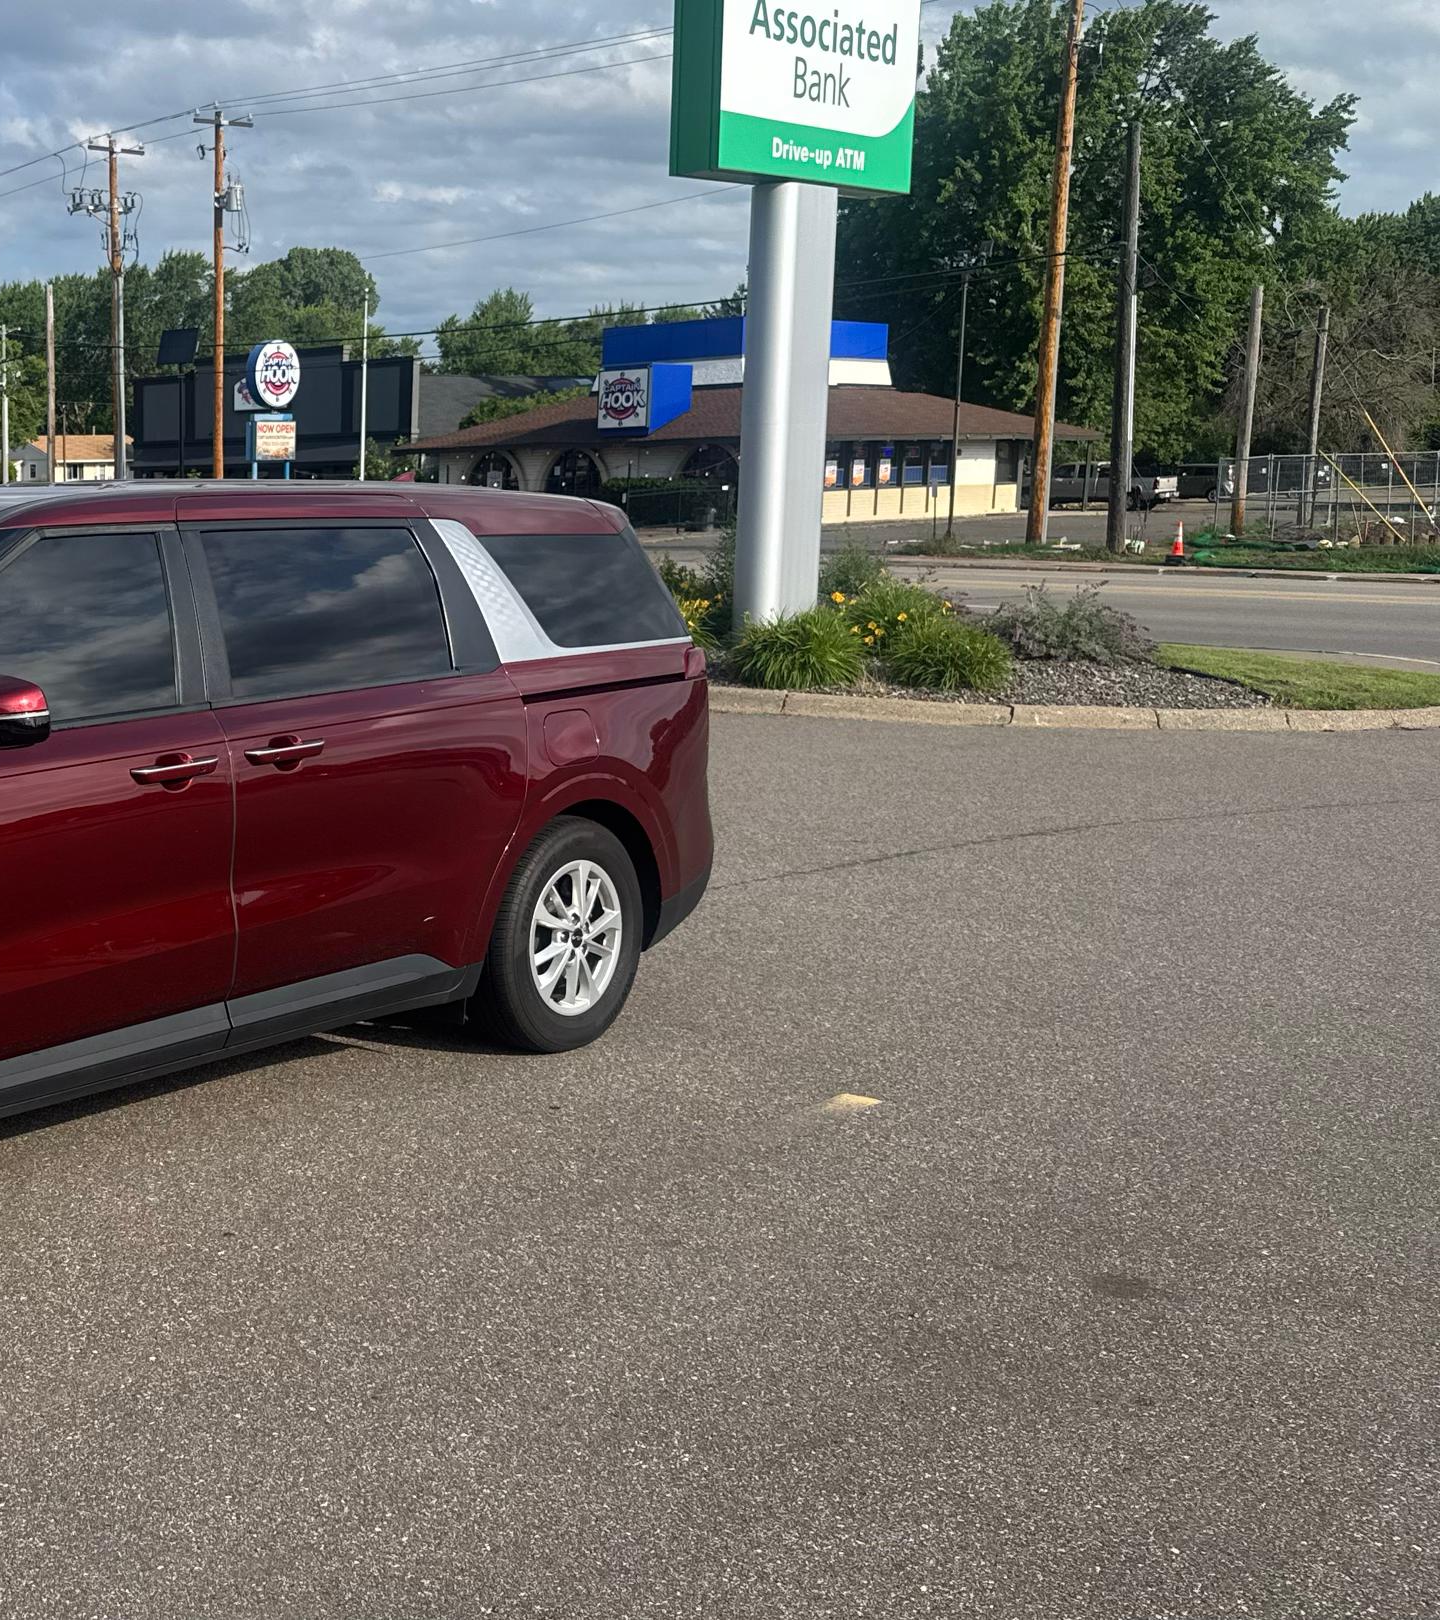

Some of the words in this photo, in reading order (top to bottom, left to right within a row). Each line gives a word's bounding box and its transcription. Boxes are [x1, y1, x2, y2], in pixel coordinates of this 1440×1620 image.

[749, 0, 898, 66] Associated
[793, 56, 851, 108] Bank
[772, 136, 833, 170] Drive-up
[835, 147, 866, 171] ATM
[260, 365, 298, 384] HOOK
[603, 382, 641, 392] CAPTAIN
[600, 390, 647, 410] HOOK
[257, 424, 274, 434] NOW
[276, 424, 295, 434] OPEN
